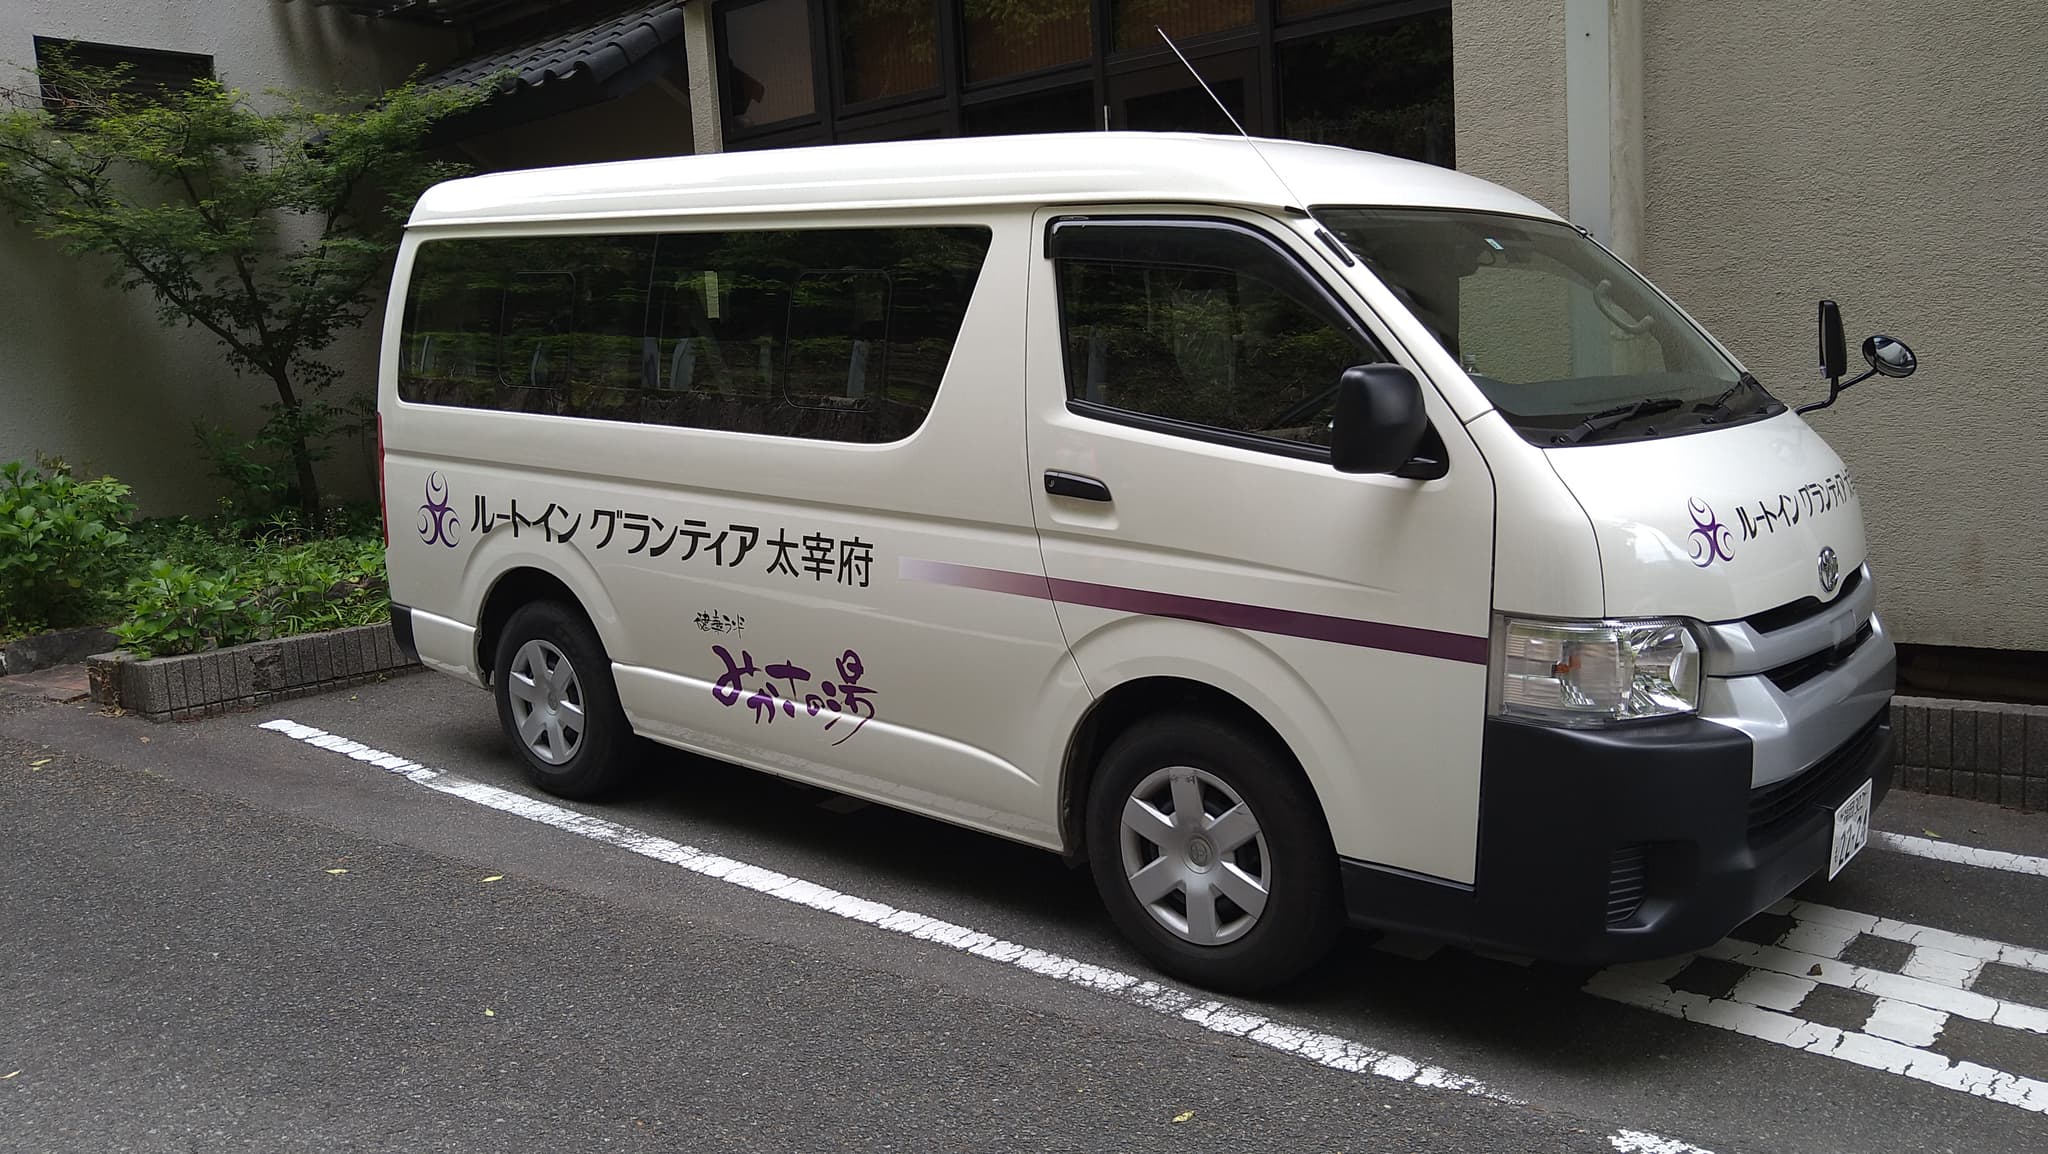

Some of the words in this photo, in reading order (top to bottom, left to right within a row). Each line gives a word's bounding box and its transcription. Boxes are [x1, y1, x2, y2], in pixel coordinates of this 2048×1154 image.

[471, 494, 582, 543] ルートイン
[589, 508, 760, 567] グランティア
[766, 527, 875, 588] 太宰府
[1735, 490, 1799, 542] ルートイン
[1798, 474, 1848, 517] グランティア
[693, 609, 746, 639] 健康ランド
